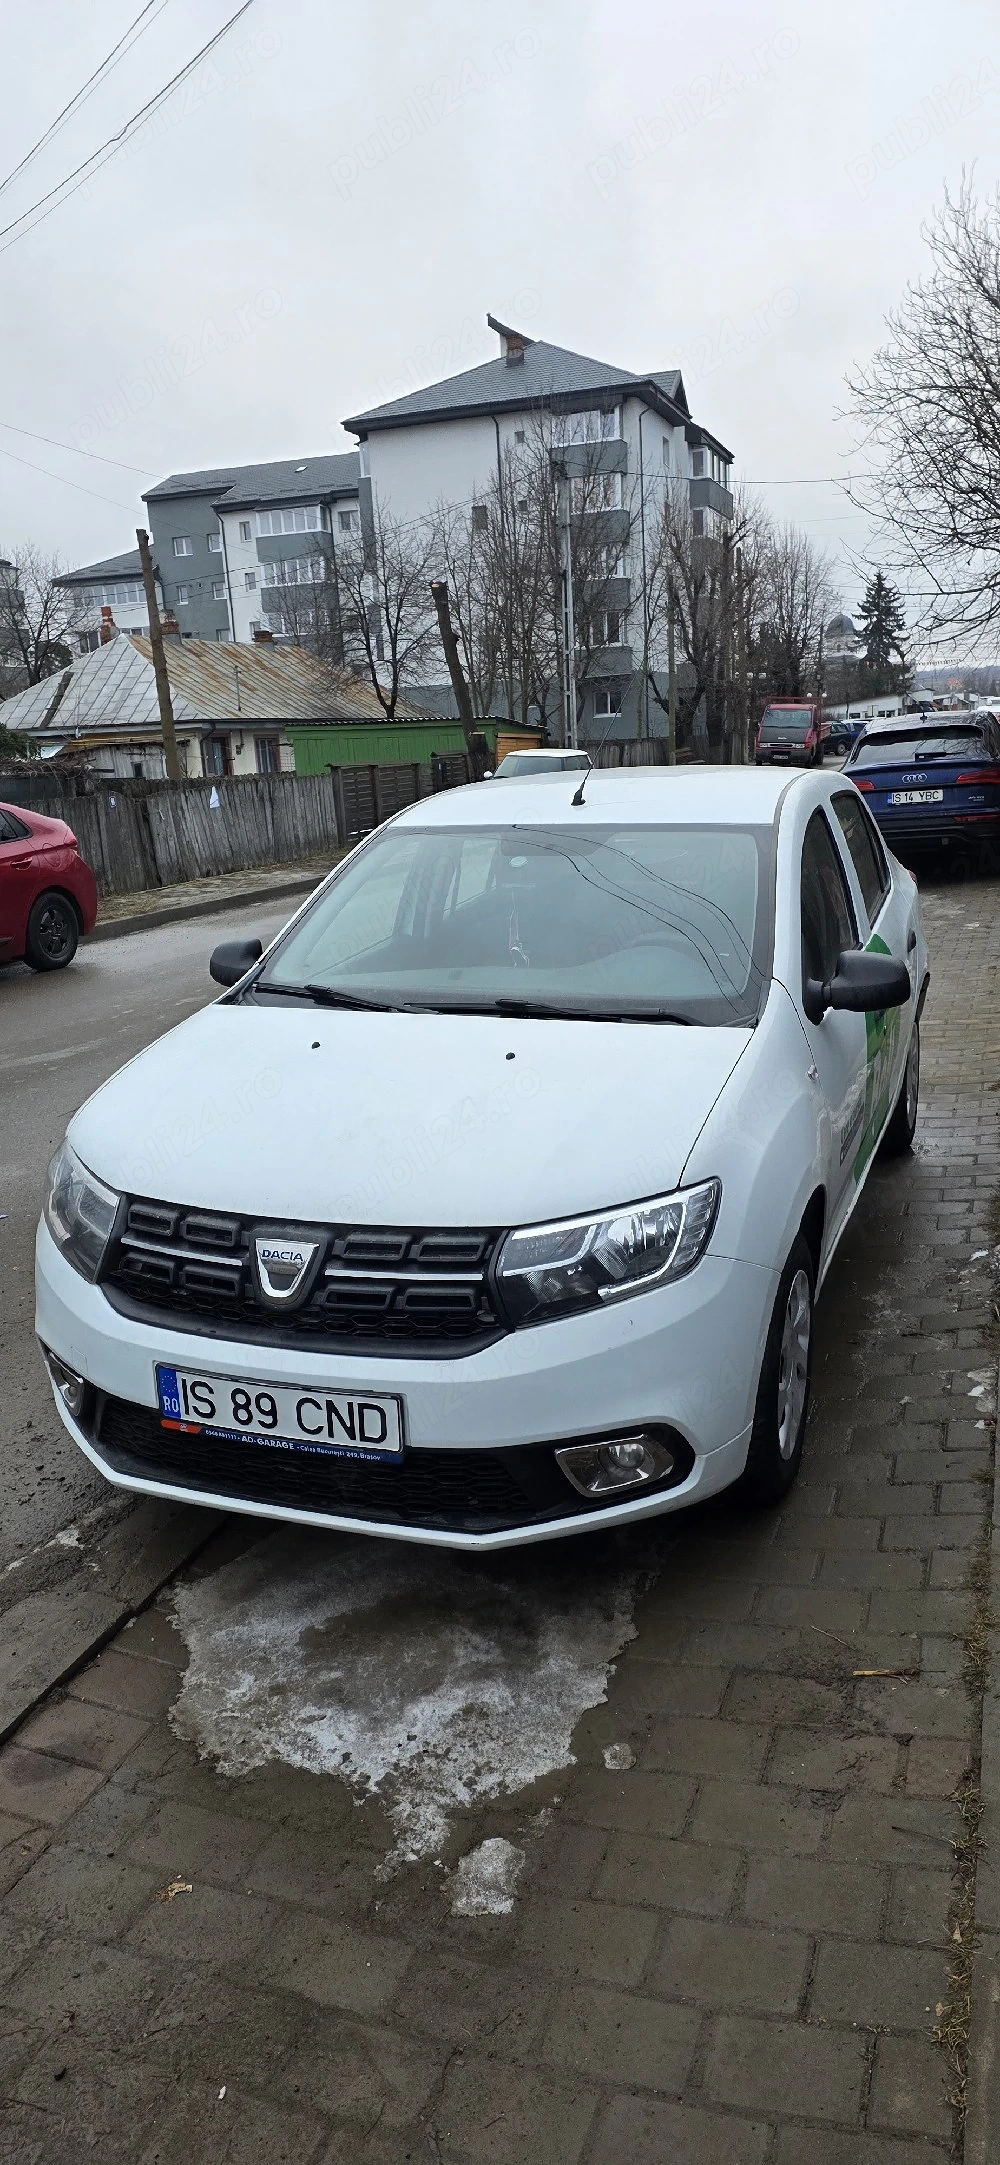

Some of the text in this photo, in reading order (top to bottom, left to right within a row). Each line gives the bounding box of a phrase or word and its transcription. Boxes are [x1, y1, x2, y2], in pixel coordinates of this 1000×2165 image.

[892, 790, 939, 803] IS 14 YBC
[261, 1249, 304, 1262] DACIA
[164, 1395, 179, 1413] RO
[181, 1378, 387, 1444] IS 89 CND
